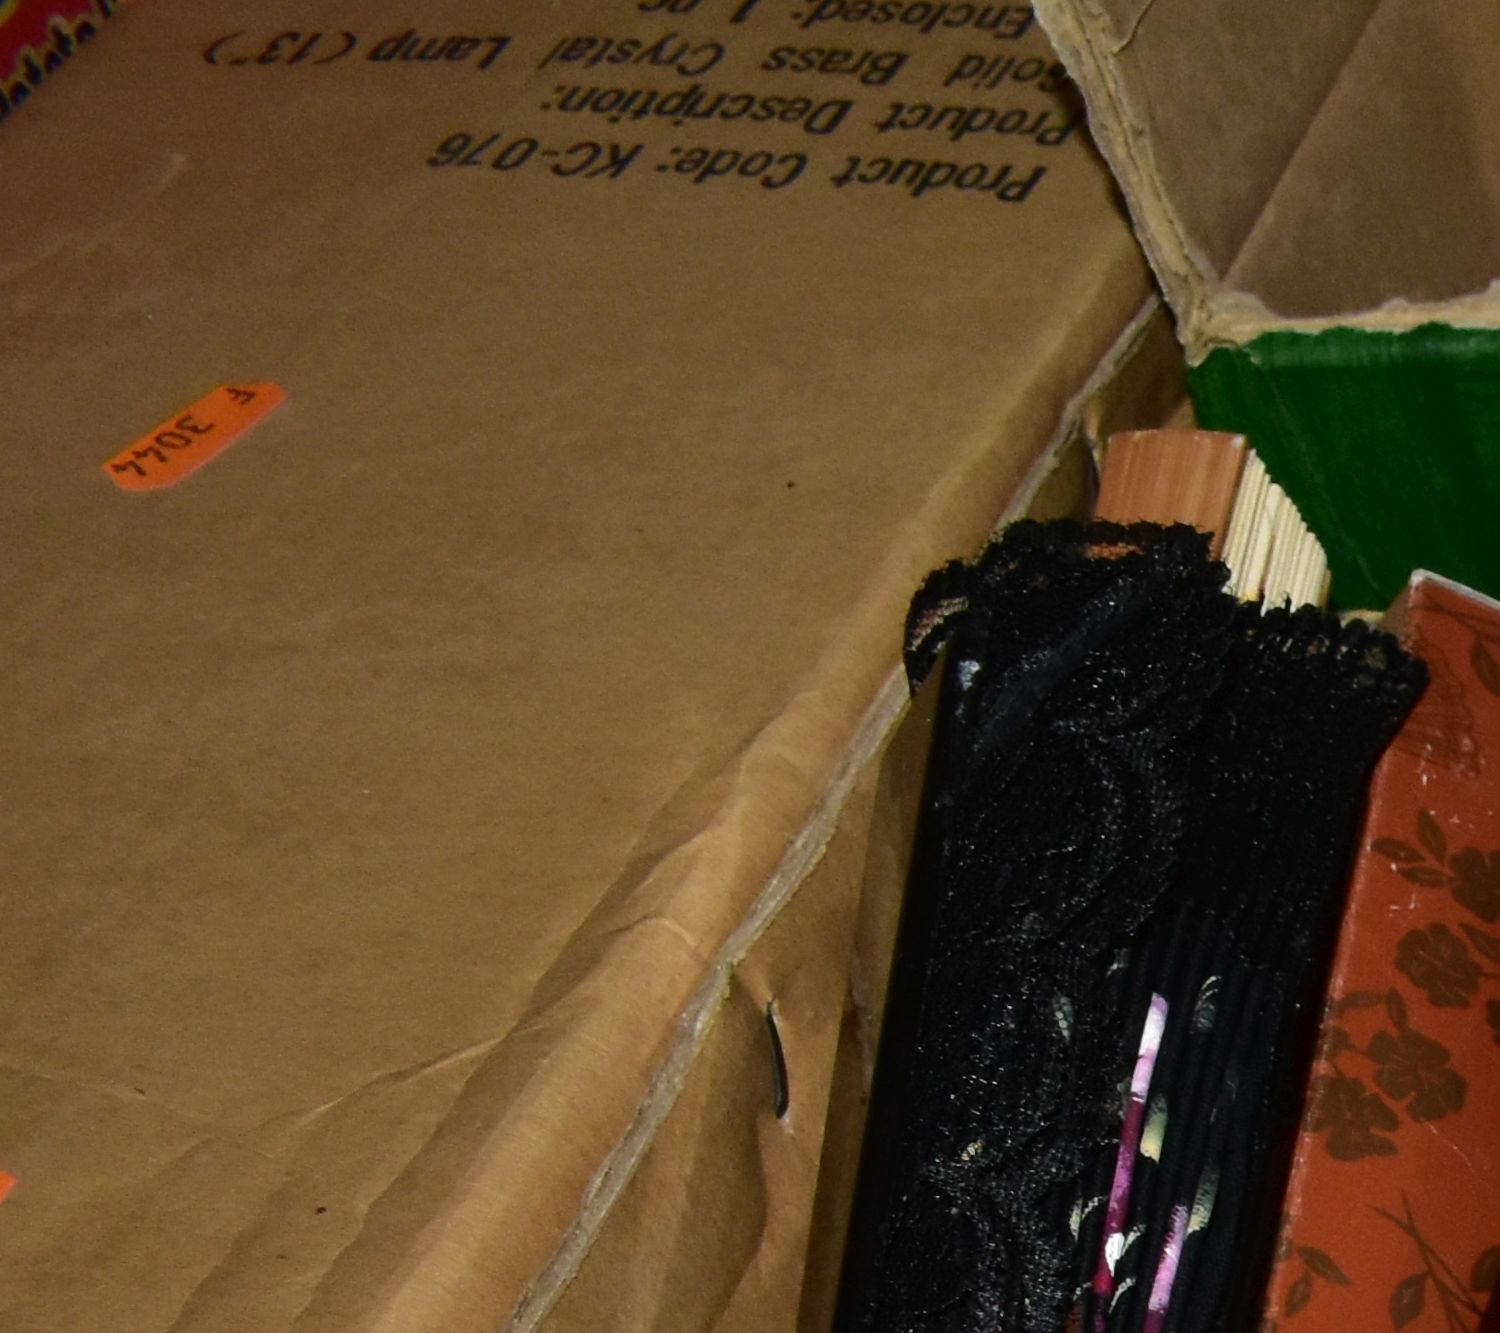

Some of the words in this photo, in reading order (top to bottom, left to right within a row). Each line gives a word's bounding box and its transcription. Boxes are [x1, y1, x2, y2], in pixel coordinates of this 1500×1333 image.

[367, 29, 512, 70] Lamp
[537, 32, 725, 78] Crystal
[761, 42, 910, 87] Brass
[944, 51, 1071, 93] Solid
[539, 83, 854, 135] Description:
[875, 100, 1081, 148] Product
[426, 132, 645, 179] KC-076
[656, 143, 808, 190] Code:
[829, 152, 1047, 202] Product
[111, 415, 214, 476] 3044
